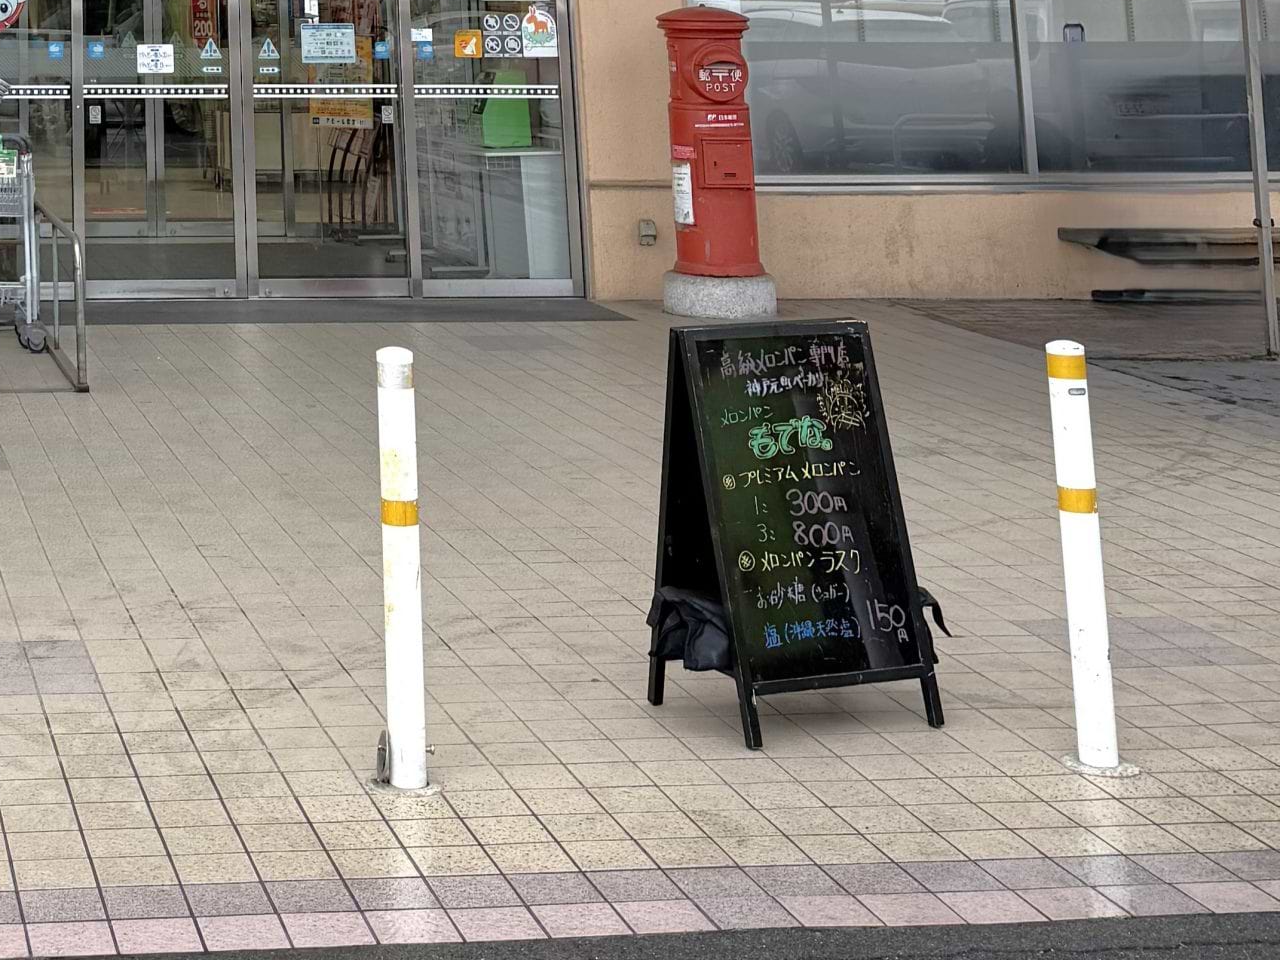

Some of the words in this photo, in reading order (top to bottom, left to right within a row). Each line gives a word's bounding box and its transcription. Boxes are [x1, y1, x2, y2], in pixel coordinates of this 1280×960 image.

[706, 83, 736, 92] POST
[720, 405, 774, 428] メロンパン
[785, 488, 848, 517] 300円
[792, 520, 854, 548] 800円
